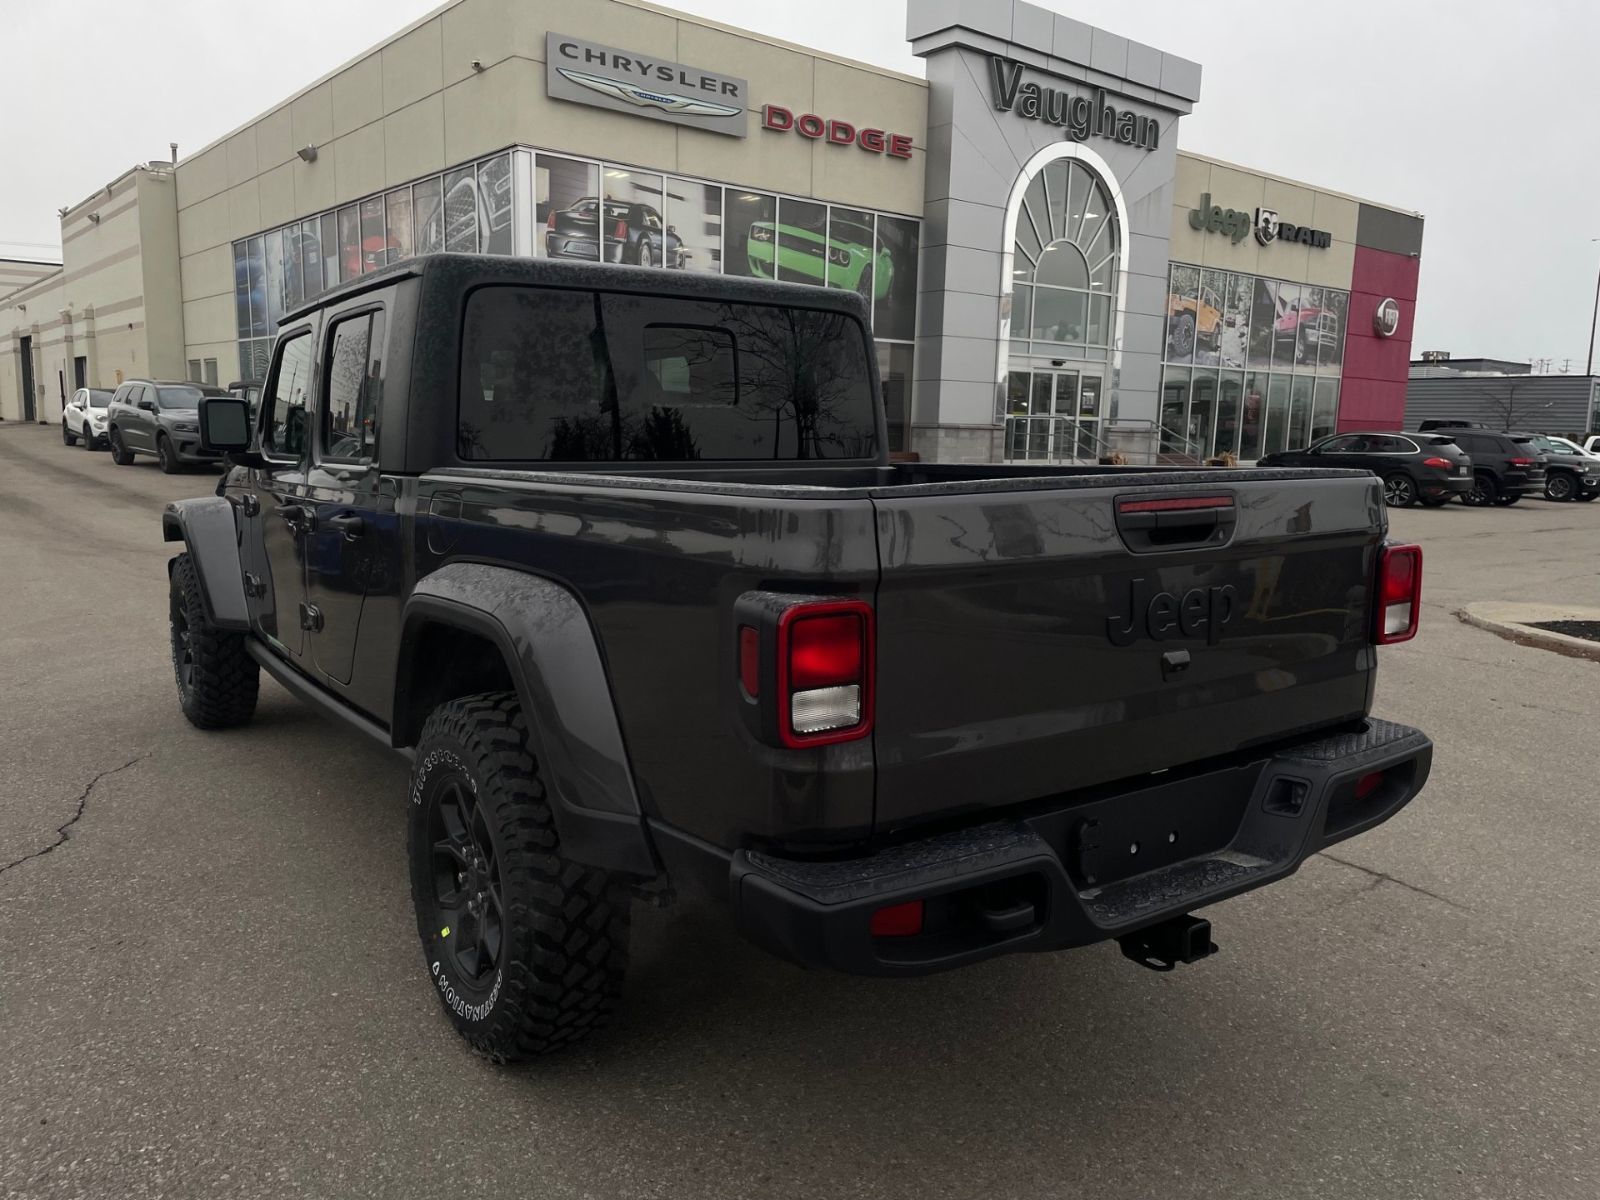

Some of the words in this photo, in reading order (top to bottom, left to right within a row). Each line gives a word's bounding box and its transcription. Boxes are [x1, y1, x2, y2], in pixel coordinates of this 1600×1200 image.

[559, 42, 739, 97] CHRYSLER
[988, 56, 1160, 150] Vaughan
[761, 104, 913, 159] DODGE
[1188, 192, 1251, 245] Jeep
[1277, 222, 1332, 249] RAM
[1106, 578, 1236, 648] Jeep
